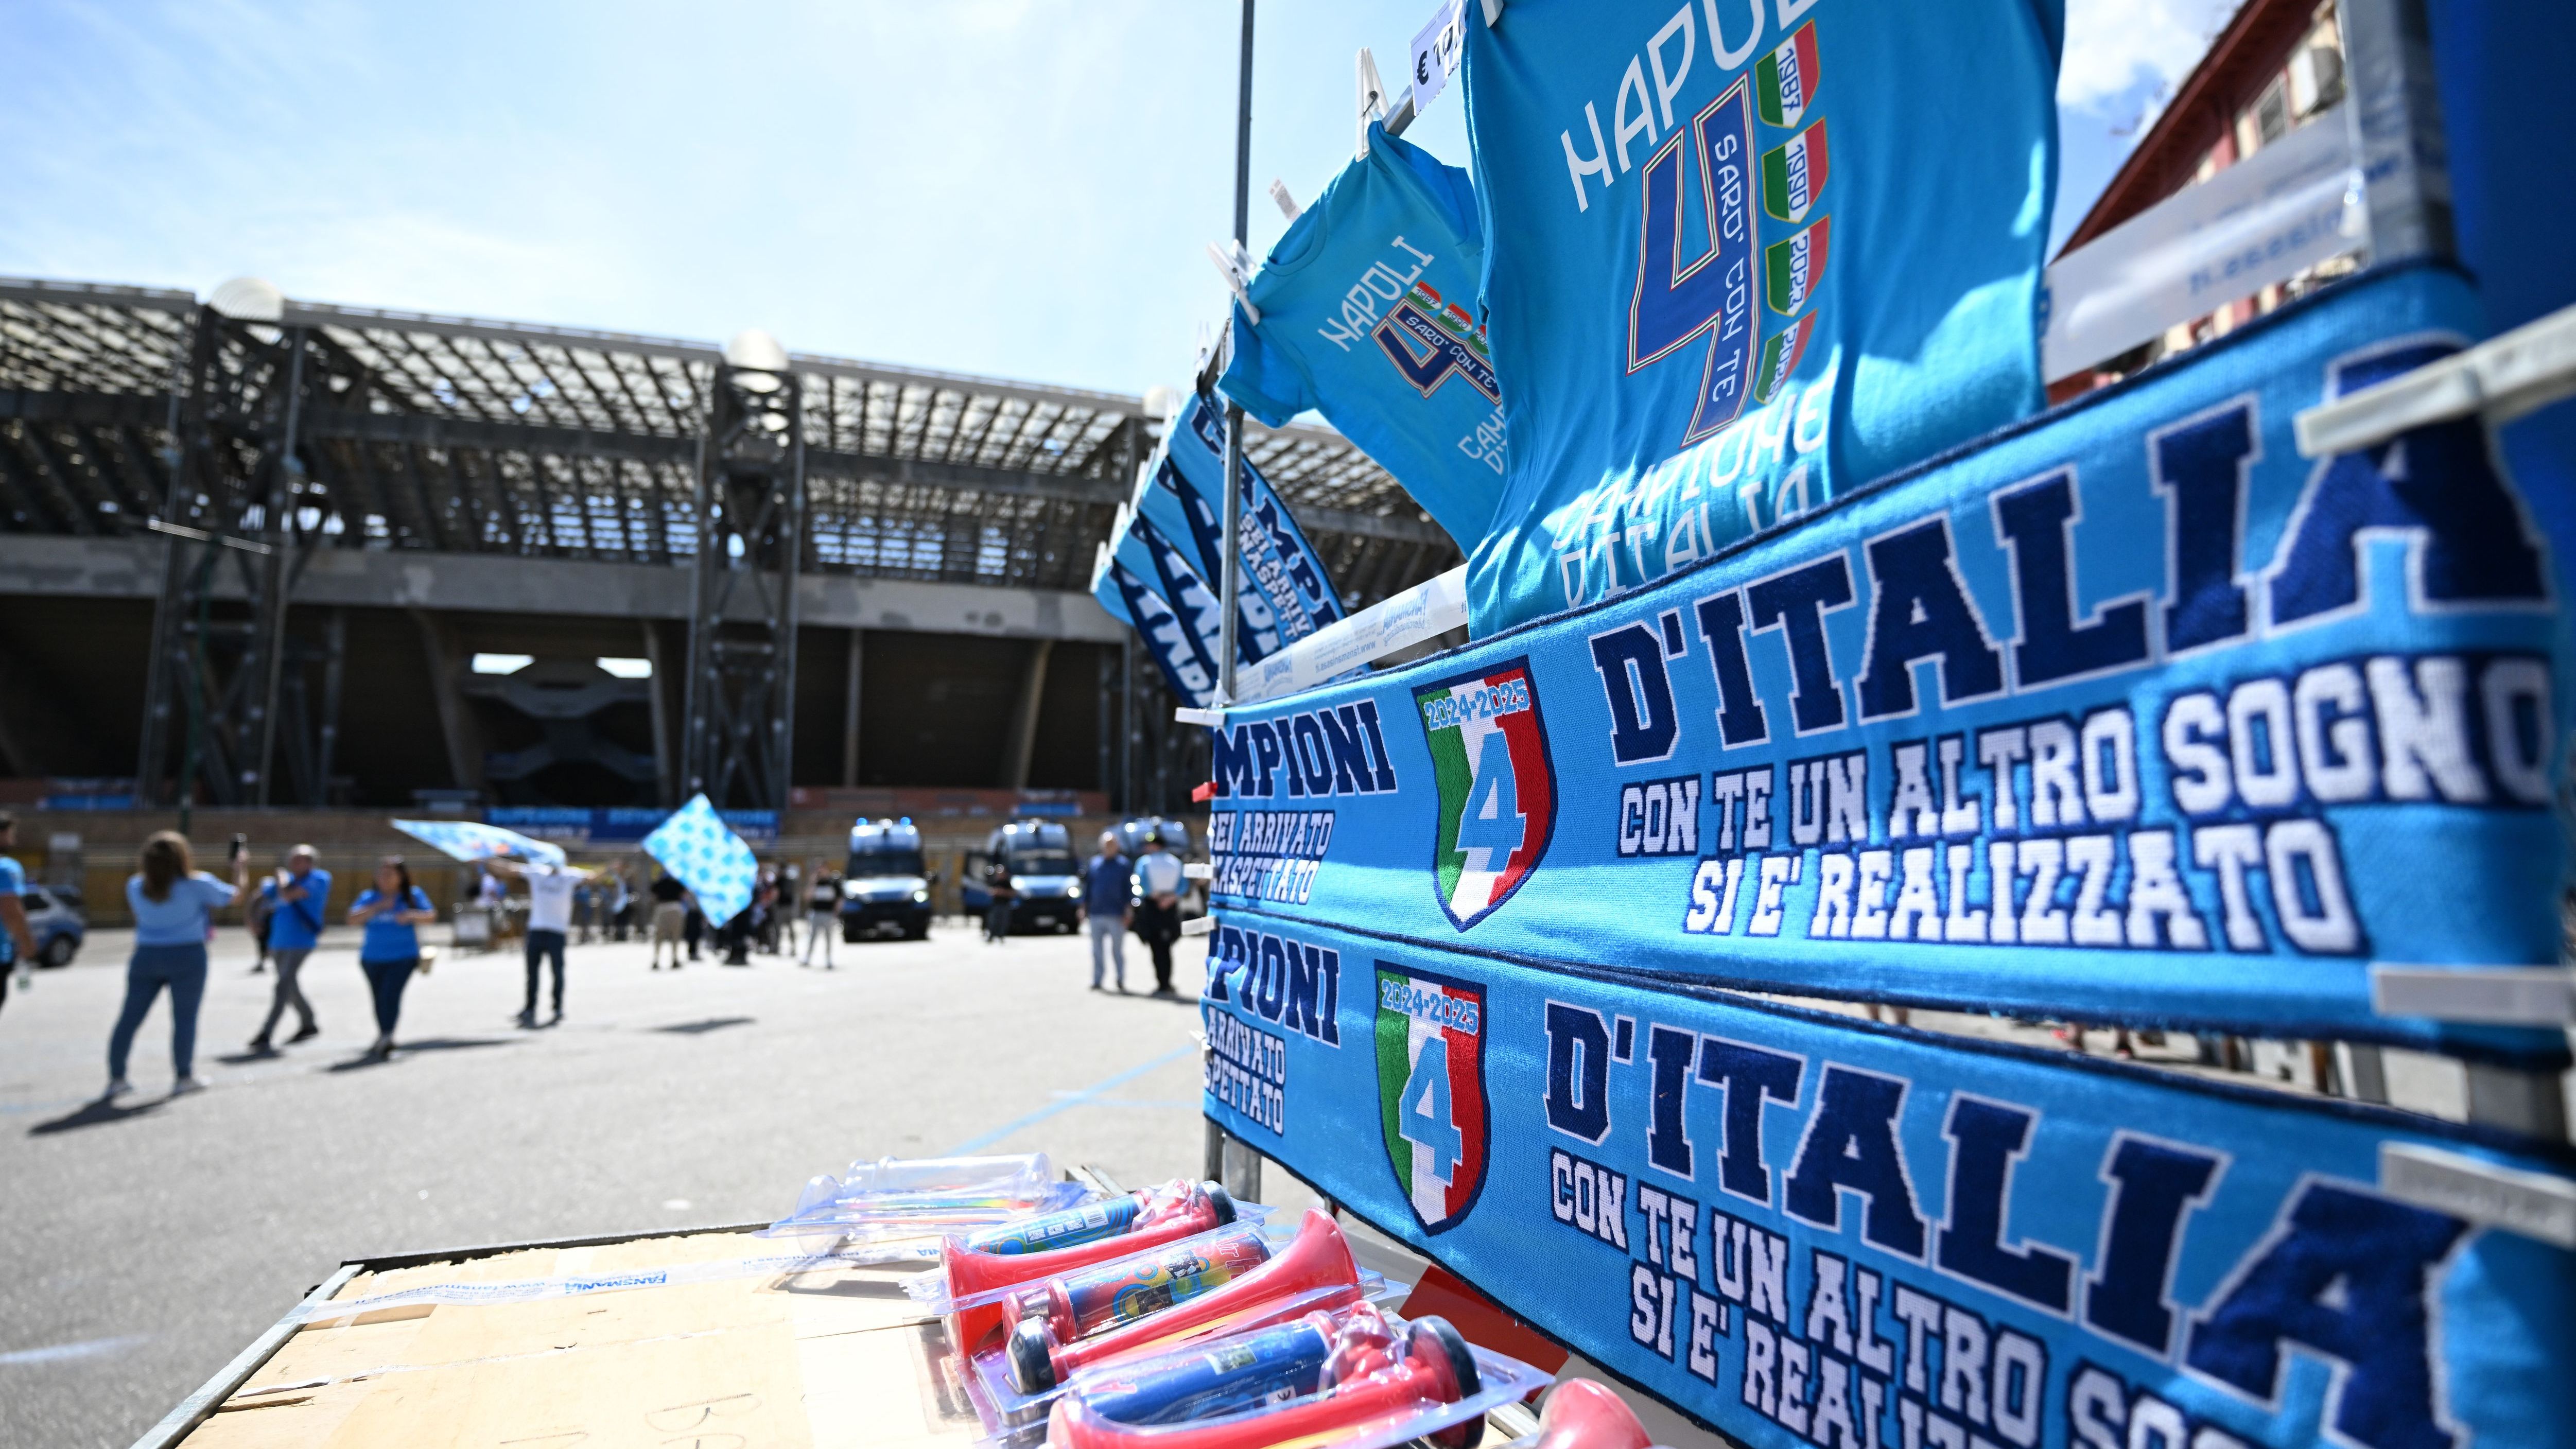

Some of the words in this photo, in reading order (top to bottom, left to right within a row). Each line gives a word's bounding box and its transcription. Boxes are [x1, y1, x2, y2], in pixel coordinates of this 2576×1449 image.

[1417, 50, 1429, 85] €
[1778, 48, 1800, 112] 1987
[1786, 144, 1808, 211] 1990
[1318, 235, 1435, 352] NAPOLI
[1417, 288, 1438, 307] 1987
[1448, 310, 1468, 329] 1990
[1723, 256, 1745, 341] CON
[1449, 345, 1476, 372] CON
[1480, 370, 1496, 388] TE
[1712, 347, 1742, 403] TE
[1551, 378, 1831, 551] CAMPIONE
[1590, 329, 2557, 767] D'ITALIA
[1424, 678, 1531, 731] 2024-2025
[1618, 779, 1701, 856] CON
[1715, 765, 1773, 850] TE
[1790, 753, 1868, 845] UN
[1888, 708, 2139, 837] ALTRO
[2164, 656, 2554, 813] SOGNO
[1238, 812, 1335, 857] ARRIVATO
[1455, 727, 1527, 876] 4
[1686, 857, 1743, 934] SI
[1749, 852, 1802, 936] E'
[1809, 819, 2361, 951] REALIZZATO
[1207, 1006, 1286, 1086] ARRIVATO
[1380, 980, 1479, 1036] 2024-2025
[1398, 1032, 1463, 1188] 4
[1543, 999, 2473, 1449] D'ITALIA
[565, 1273, 667, 1294] FANSMANIA
[1552, 1151, 1627, 1249] CON
[1639, 1185, 1698, 1281] TE
[1713, 1215, 1788, 1324] UN
[1807, 1253, 2045, 1447] ALTRO
[1631, 1264, 1675, 1357] SI
[1690, 1292, 1727, 1381] E'
